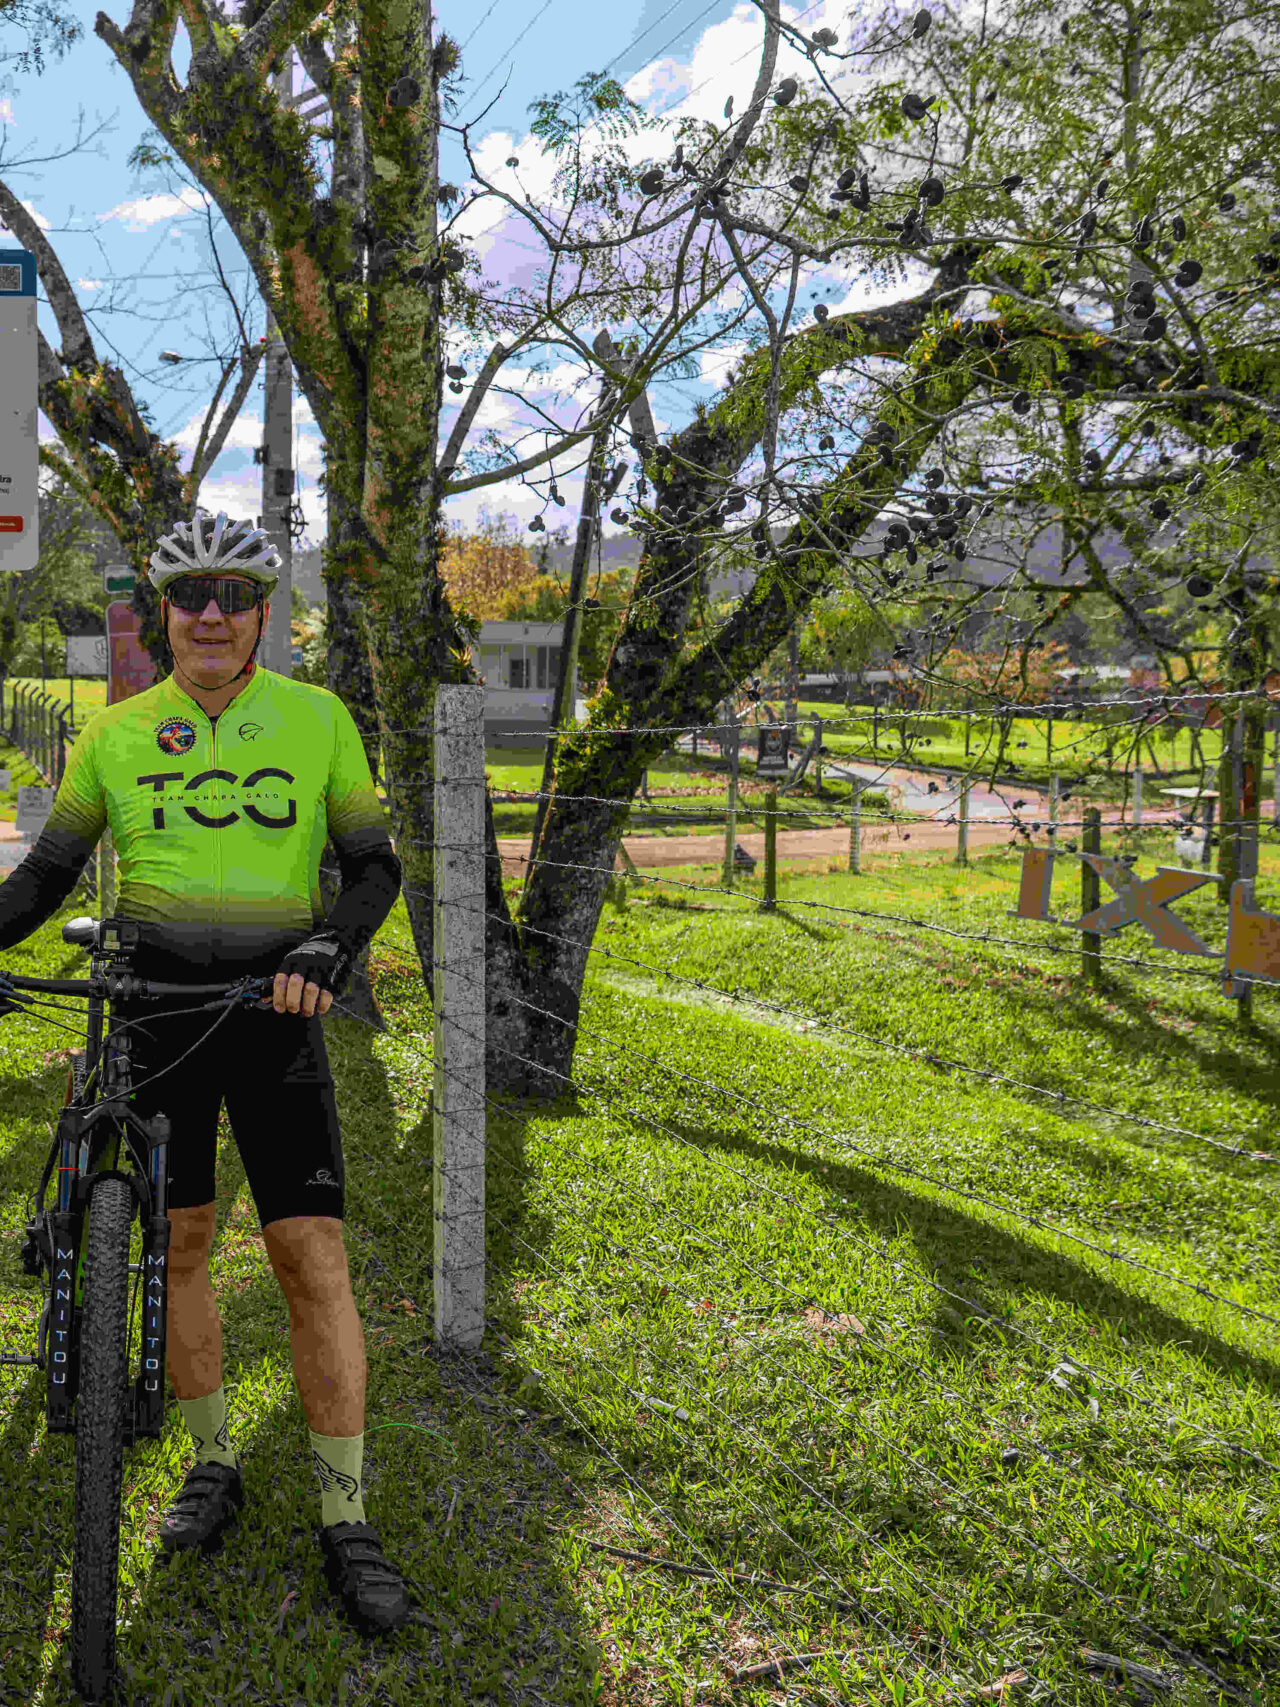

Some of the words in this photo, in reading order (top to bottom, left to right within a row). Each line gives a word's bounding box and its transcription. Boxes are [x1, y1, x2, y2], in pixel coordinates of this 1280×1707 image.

[136, 767, 297, 830] TCG
[152, 794, 185, 803] TEAM
[193, 793, 237, 801] CHAPA
[245, 792, 280, 800] GALO
[52, 1247, 73, 1385] MANITOU
[144, 1253, 165, 1392] MANITOU
